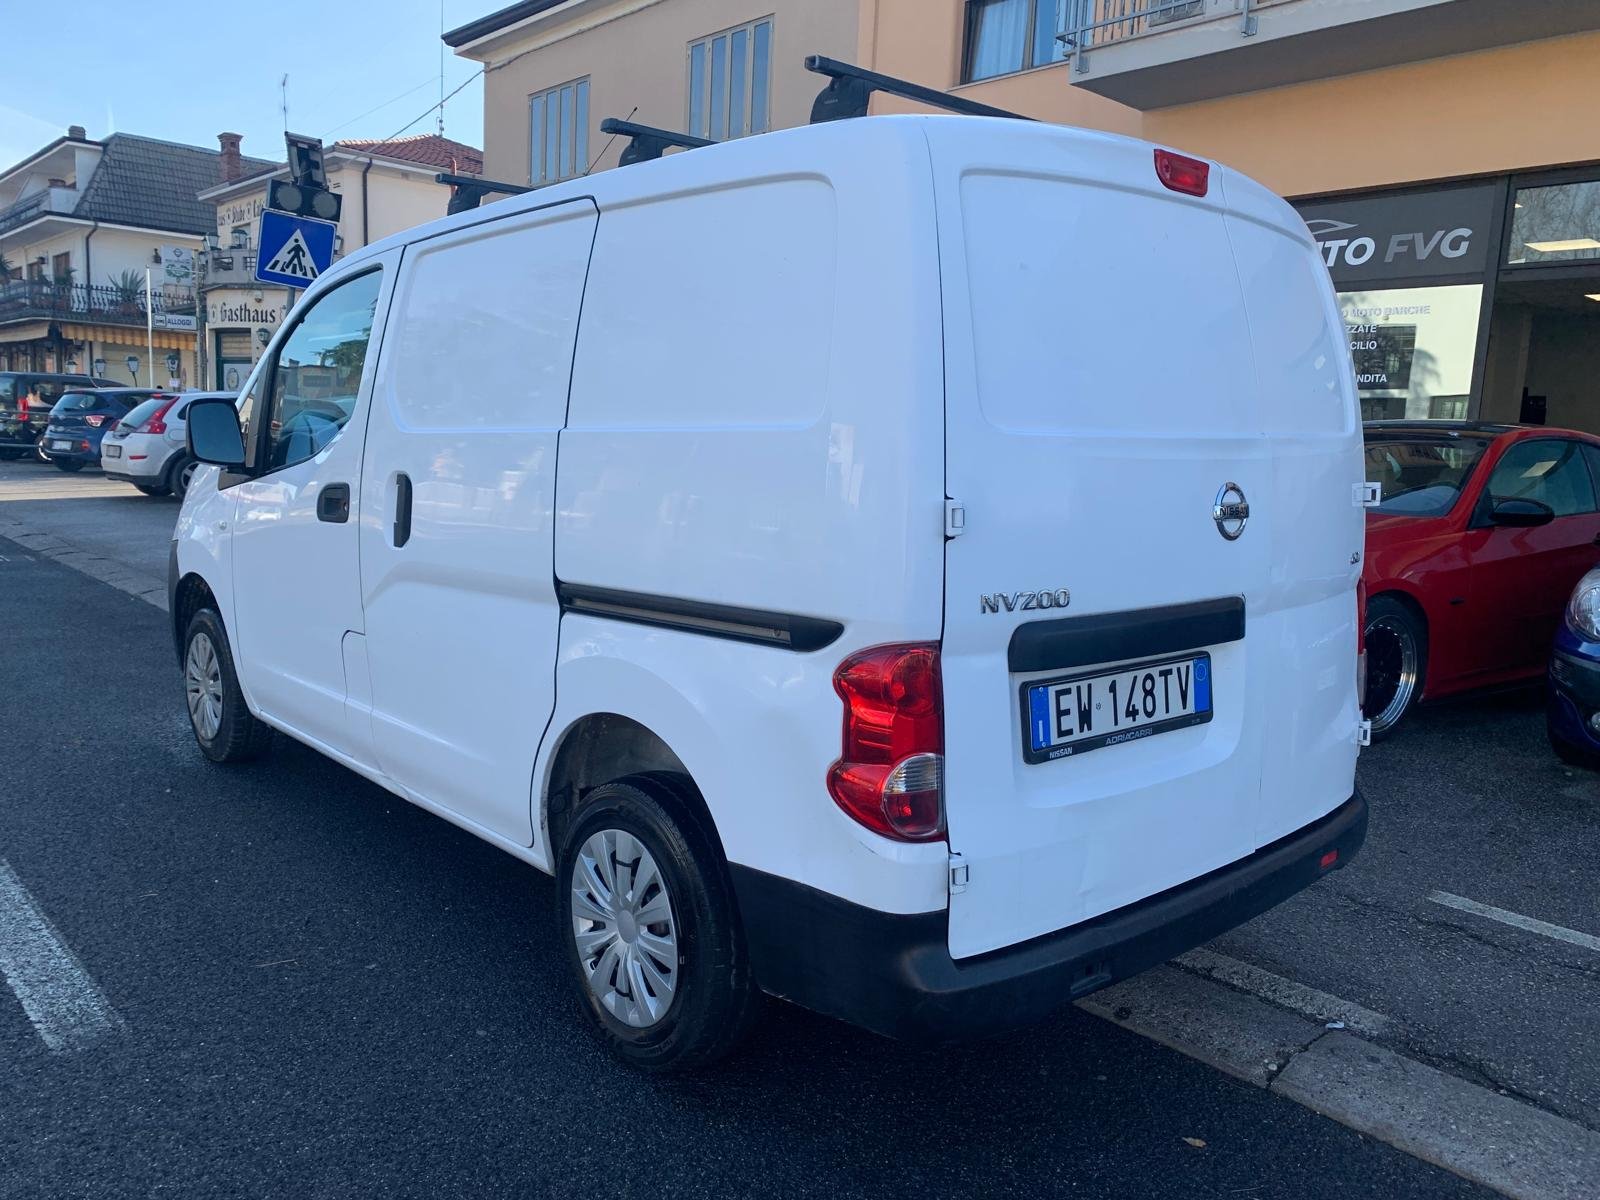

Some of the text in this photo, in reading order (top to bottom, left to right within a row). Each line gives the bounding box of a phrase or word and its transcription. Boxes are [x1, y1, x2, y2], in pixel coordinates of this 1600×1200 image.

[1384, 227, 1473, 263] FVG
[220, 302, 276, 323] Gasthaus
[1352, 307, 1382, 318] MOTO
[167, 317, 192, 326] ALLOGGI
[1350, 341, 1377, 350] CILIO
[1356, 374, 1387, 383] NDITA
[980, 588, 1070, 614] NV200
[1055, 665, 1190, 739] EW 148TV
[1105, 728, 1153, 746] ADRIACARRI
[1049, 747, 1073, 759] NISSAN
